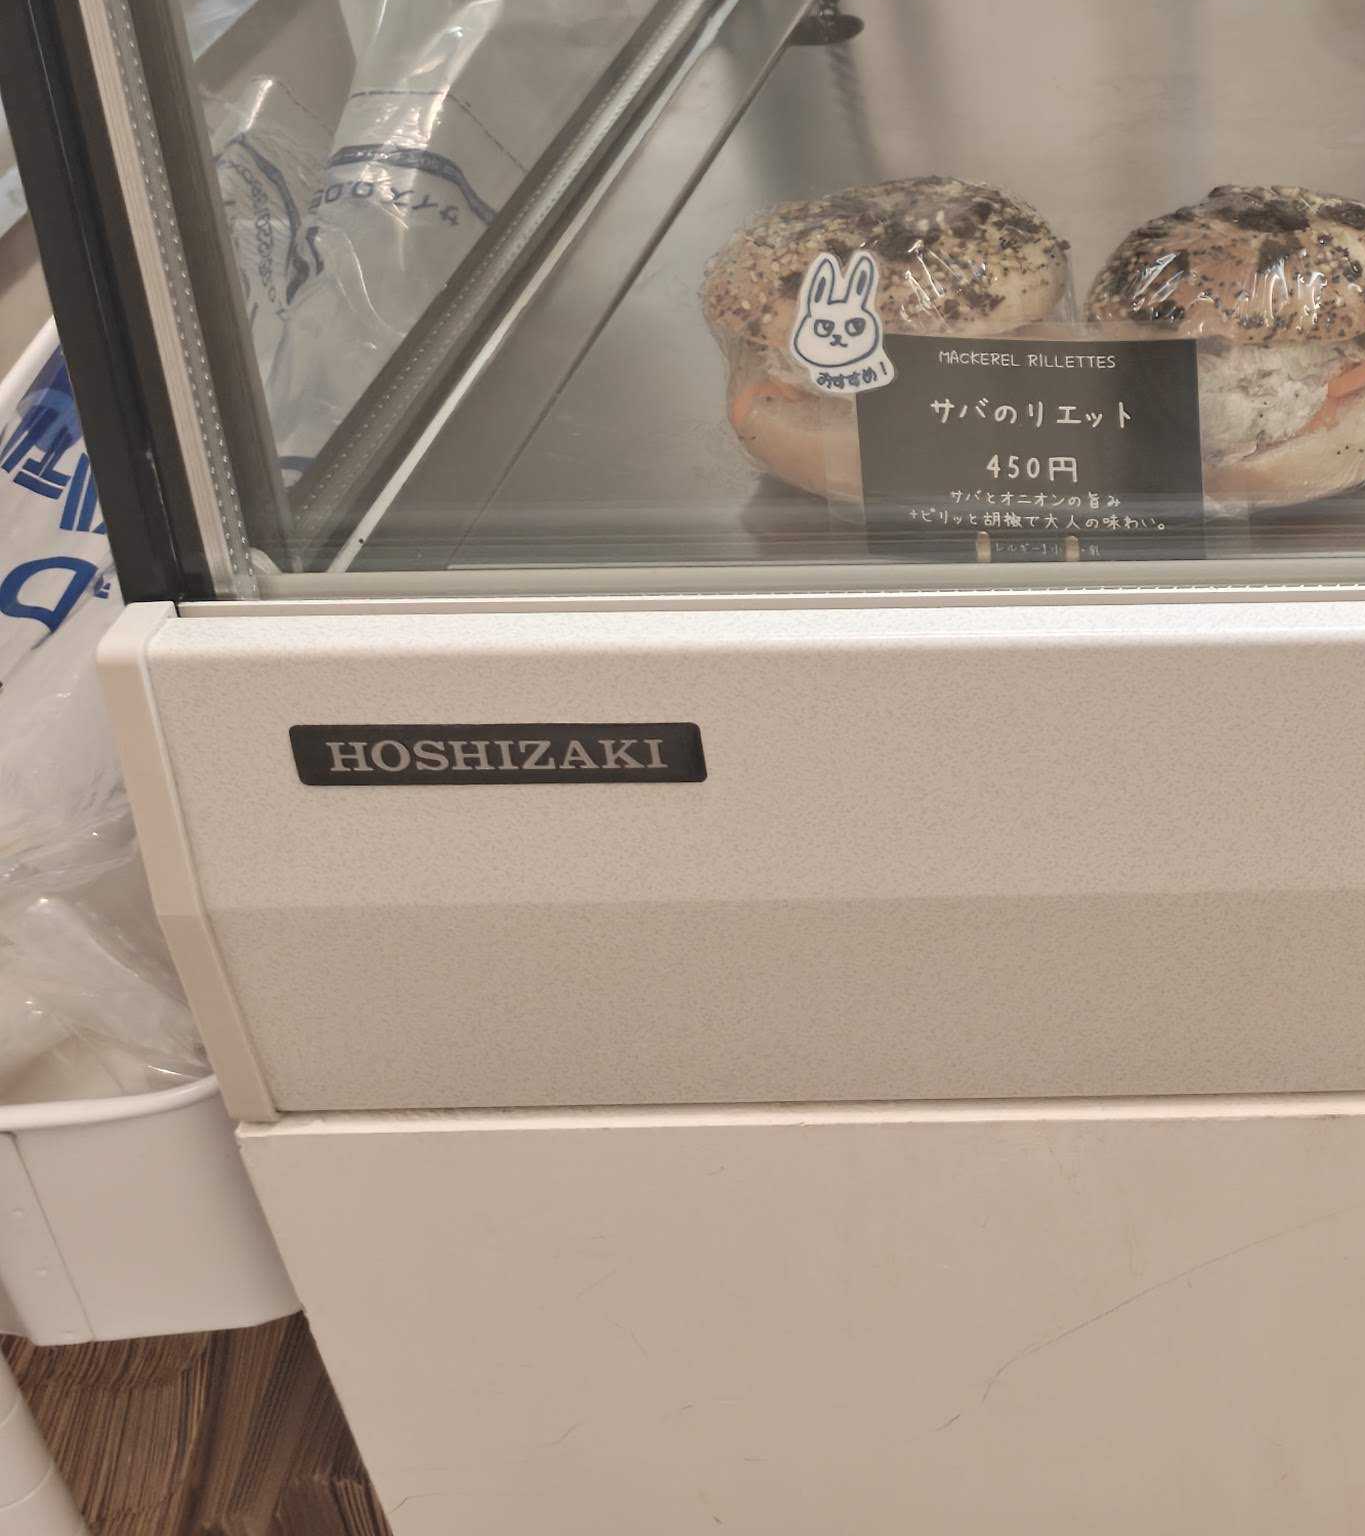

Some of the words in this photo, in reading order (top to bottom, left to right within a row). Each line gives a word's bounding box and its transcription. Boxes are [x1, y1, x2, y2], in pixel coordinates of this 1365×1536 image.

[939, 350, 1019, 368] MACKEREL
[1028, 353, 1116, 370] RILLETTES
[931, 398, 1134, 429] サバのリエット
[986, 454, 1079, 483] 450円
[950, 490, 1121, 509] サバとオニオンの旨み
[325, 738, 669, 773] HOSHIZAKI
